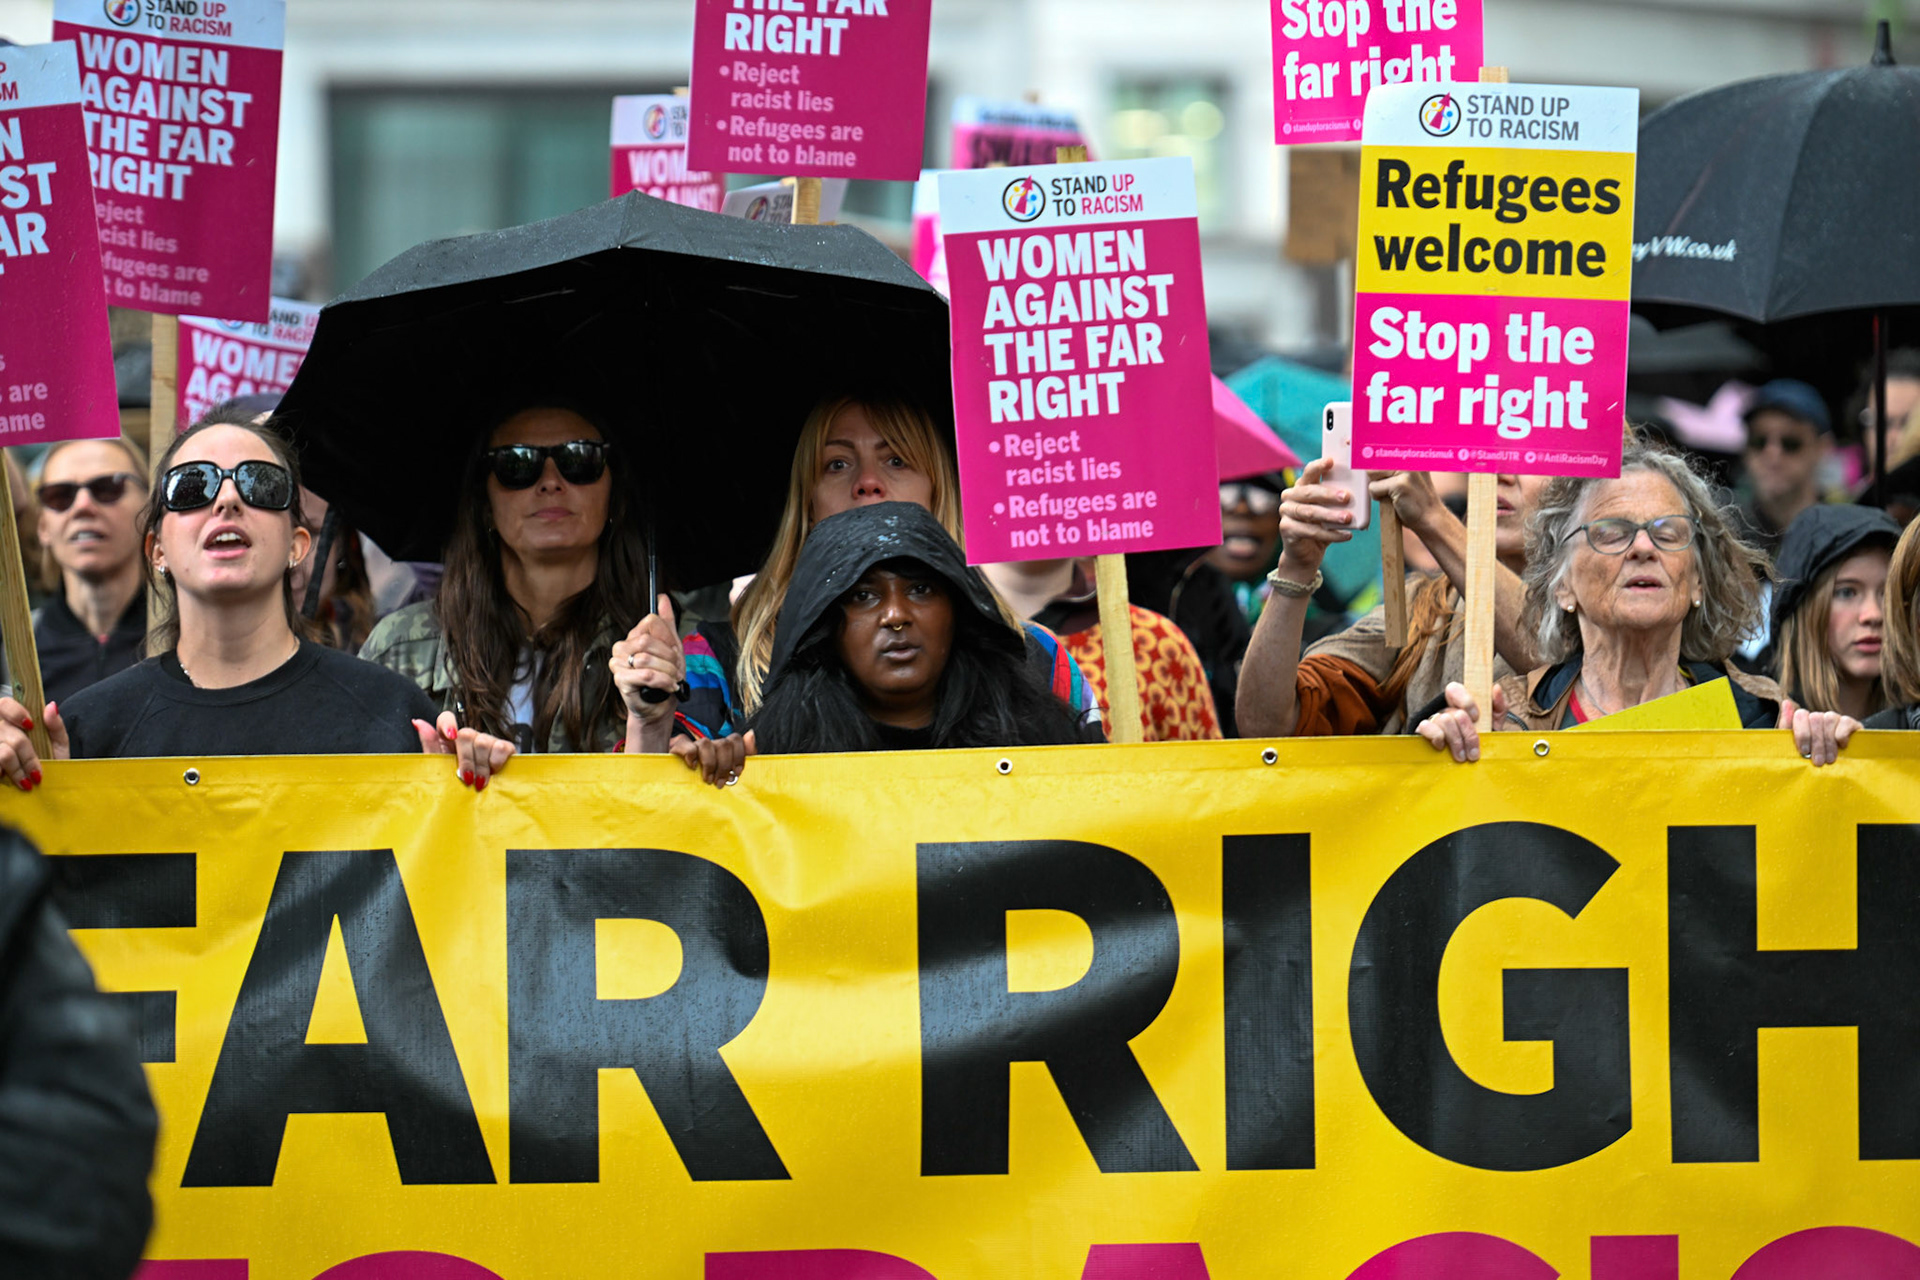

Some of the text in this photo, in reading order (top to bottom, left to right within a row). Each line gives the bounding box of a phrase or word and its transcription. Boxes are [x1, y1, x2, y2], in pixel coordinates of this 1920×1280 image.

[146, 0, 226, 18] STAND UP
[146, 13, 232, 37] TO RACISM
[724, 12, 848, 56] RIGHT
[1281, 0, 1457, 48] Stop the
[80, 32, 229, 86] WOMEN
[733, 60, 800, 87] Reject
[1283, 44, 1456, 100] far right
[81, 72, 252, 128] AGAINST
[730, 89, 834, 112] racist lies
[1466, 95, 1569, 117] STAND UP
[83, 110, 235, 166] THE FAR
[730, 115, 864, 143] Refugees are
[1466, 118, 1579, 141] TO RACISM
[728, 143, 857, 167] not to blame
[1051, 174, 1134, 196] STAND UP
[1376, 159, 1621, 223] Refugees
[1052, 194, 1143, 217] TO RACISM
[141, 230, 178, 253] lies
[977, 229, 1146, 281] WOMEN
[1373, 223, 1606, 278] welcome
[1632, 235, 1738, 262] yVW.co.uk
[174, 265, 209, 282] are
[115, 279, 135, 298] to
[139, 282, 202, 306] blame
[983, 273, 1174, 329] AGAINST
[984, 322, 1164, 376] THE FAR
[1368, 306, 1595, 373] Stop the
[9, 382, 48, 402] are
[988, 371, 1125, 423] RIGHT
[1366, 371, 1588, 439] far right
[1004, 430, 1080, 460] Reject
[1375, 447, 1454, 460] standuptoracismuk
[1006, 457, 1122, 486] racist lies
[1008, 490, 1157, 520] Refugees are
[1010, 518, 1154, 548] not to blame
